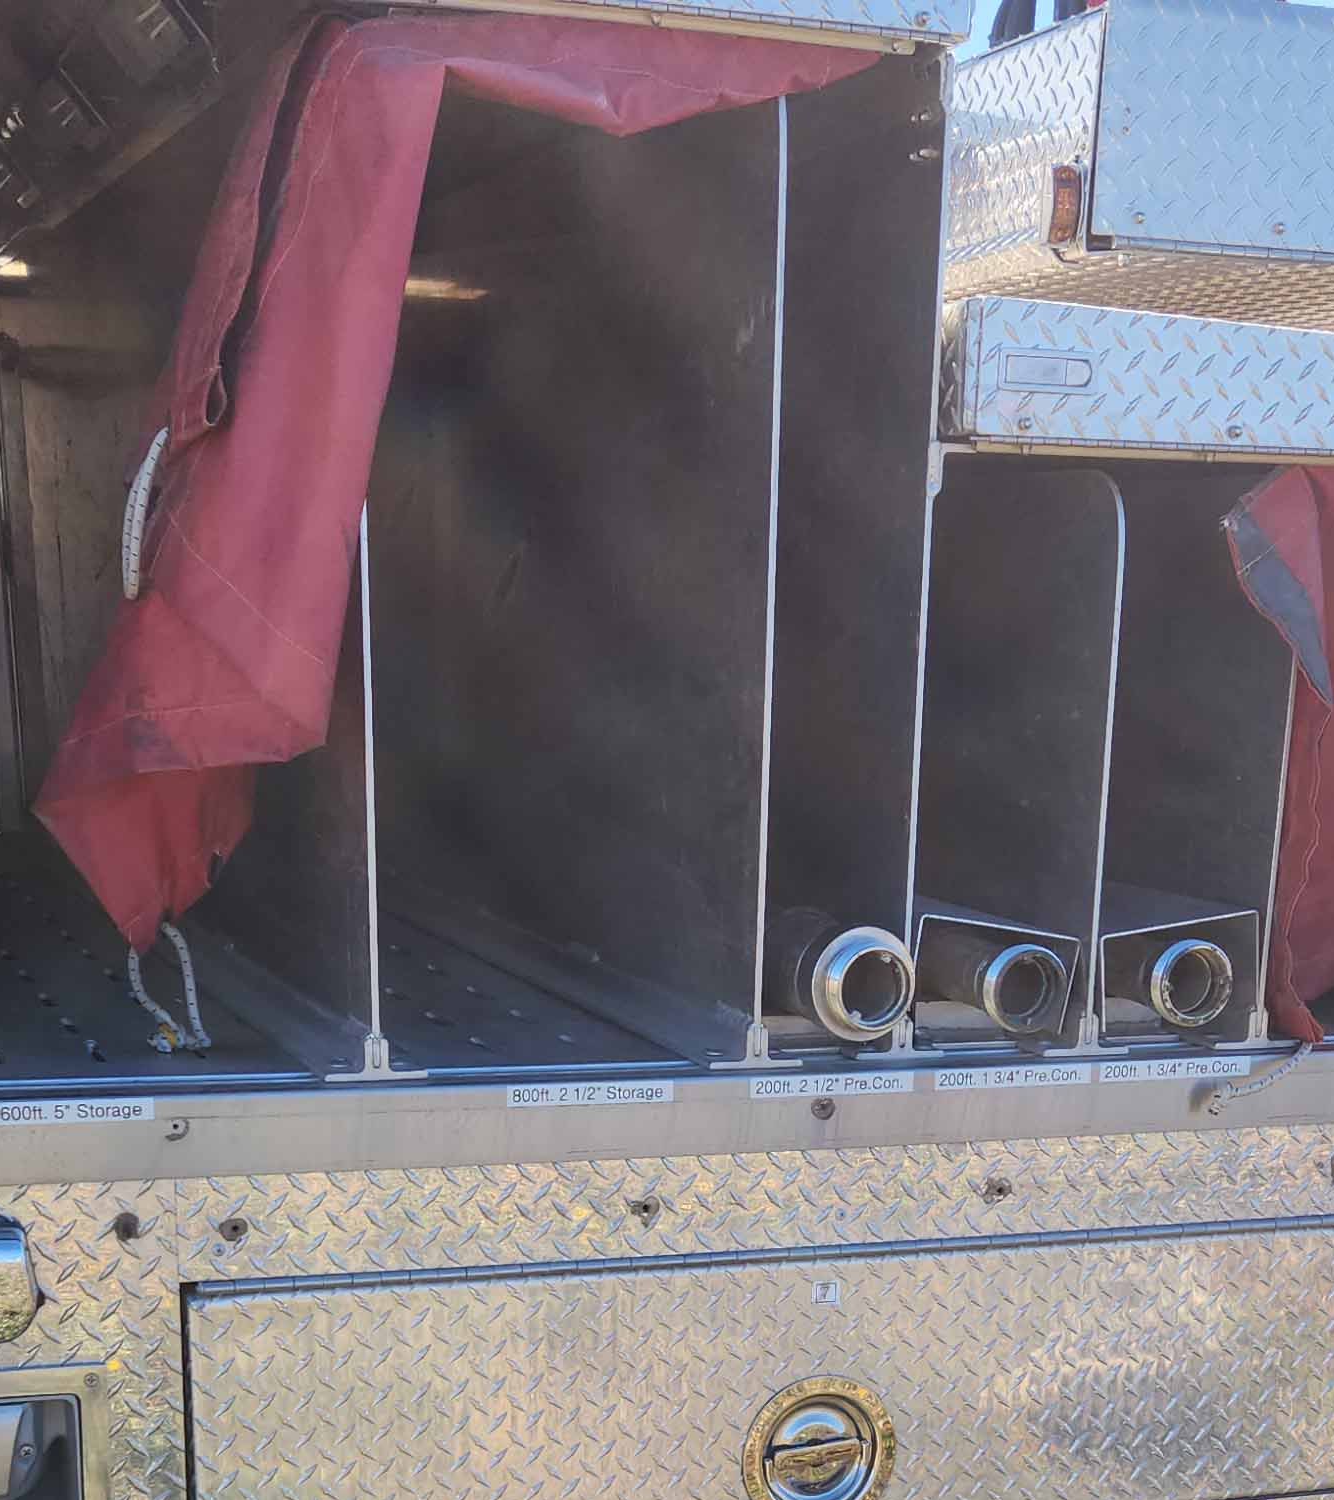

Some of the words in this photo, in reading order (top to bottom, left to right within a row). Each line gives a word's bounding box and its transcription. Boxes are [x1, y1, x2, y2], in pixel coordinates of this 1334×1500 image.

[939, 1072, 977, 1087] 200ft.
[1024, 1068, 1082, 1082] Pre.Con.
[1105, 1065, 1140, 1079] 200ft.
[1186, 1061, 1241, 1074] Pre.Con.
[755, 1080, 794, 1094] 200ft.
[799, 1080, 808, 1093] 2
[844, 1076, 904, 1091] Pre.Con.
[512, 1088, 554, 1103] 800ft.
[559, 1088, 568, 1101] 2
[606, 1086, 663, 1100] Storage
[0, 1106, 48, 1121] 600ft.
[77, 1103, 142, 1119] Storage
